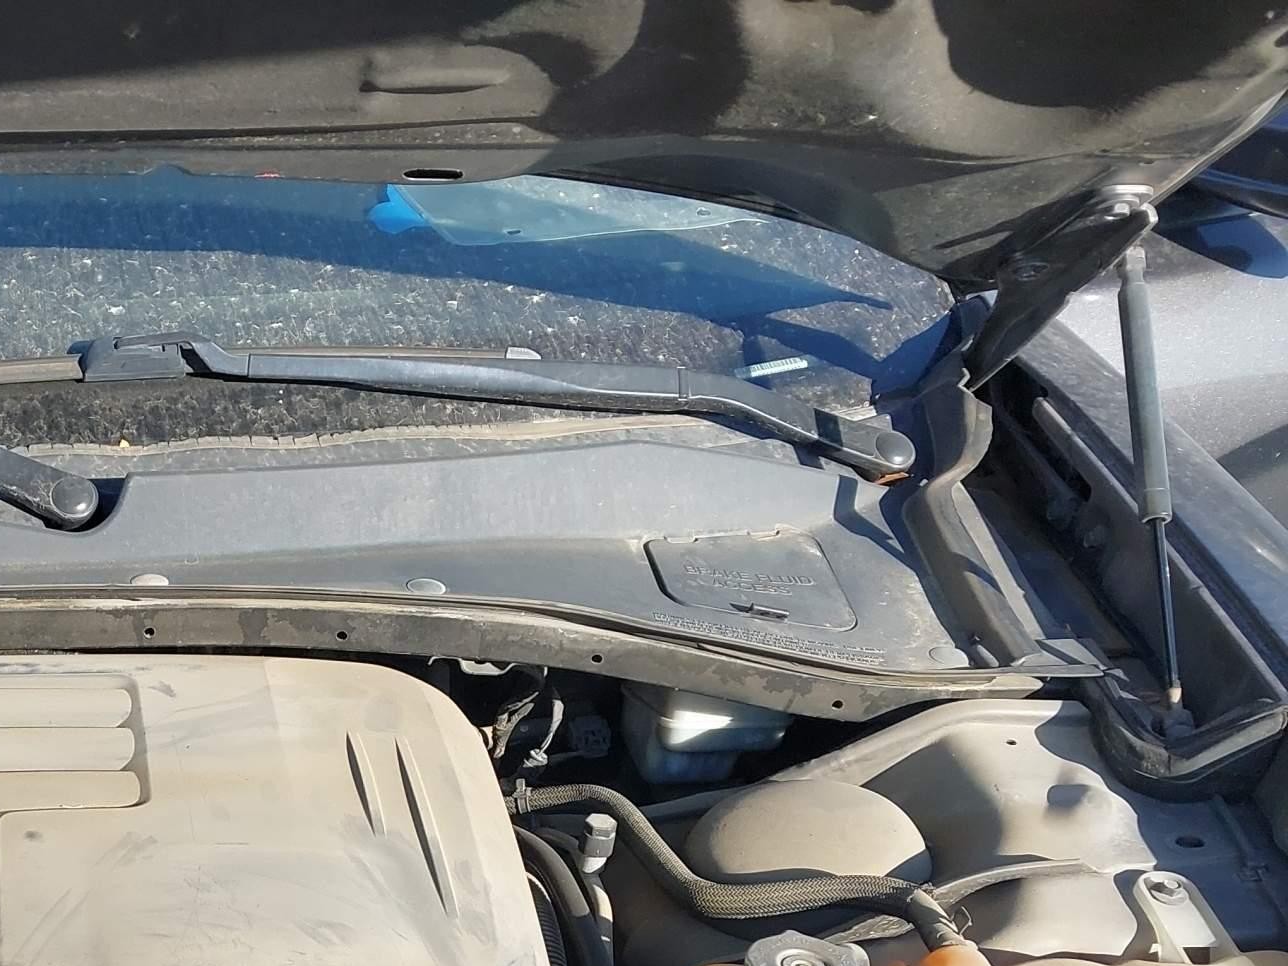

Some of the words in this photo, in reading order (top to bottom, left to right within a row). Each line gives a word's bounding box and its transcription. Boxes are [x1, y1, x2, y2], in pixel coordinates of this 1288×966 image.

[684, 564, 753, 582] BRAKE
[755, 572, 816, 586] FLUID
[712, 577, 793, 596] ACCESS
